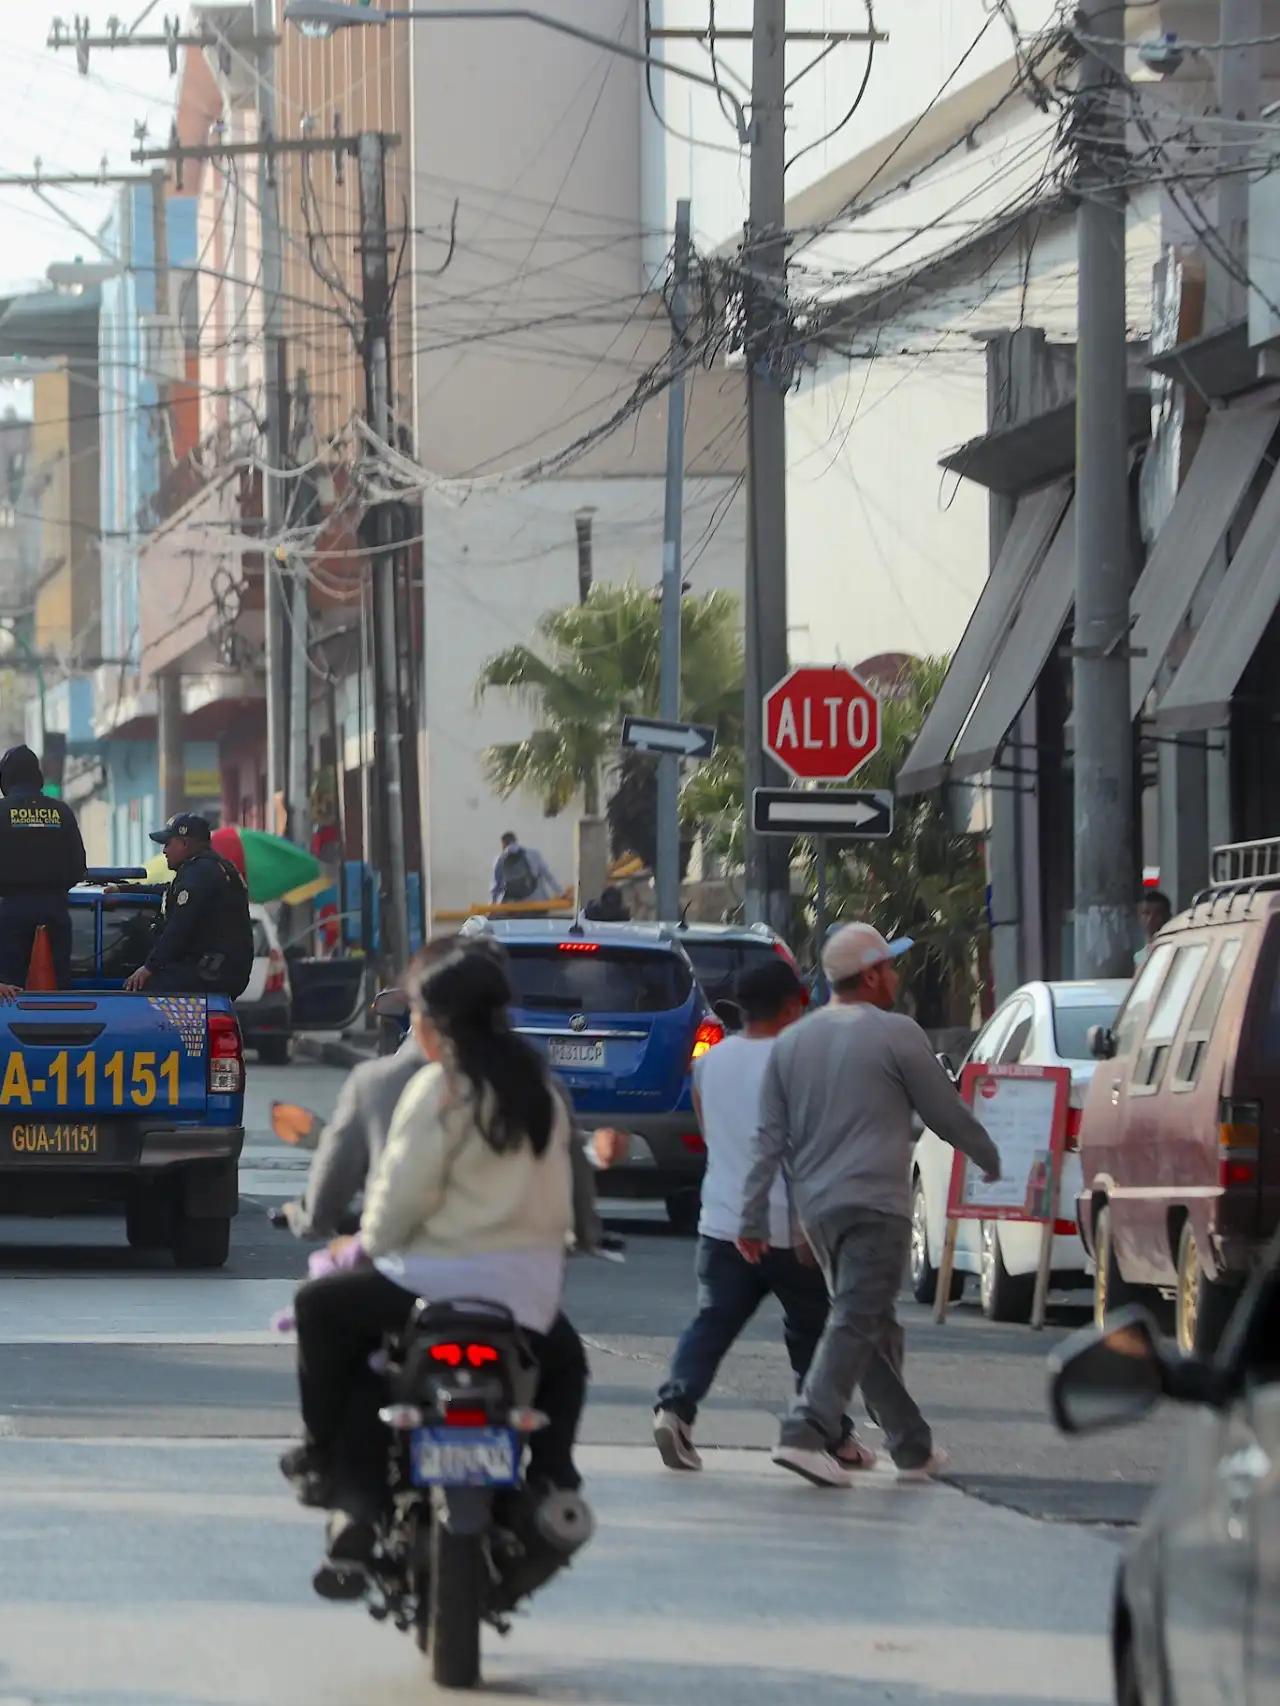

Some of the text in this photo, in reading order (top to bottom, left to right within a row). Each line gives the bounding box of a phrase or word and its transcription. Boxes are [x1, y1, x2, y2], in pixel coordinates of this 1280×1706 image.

[775, 697, 870, 749] ALTO
[10, 808, 60, 818] POLICIA
[12, 1124, 97, 1152] GUA-11151
